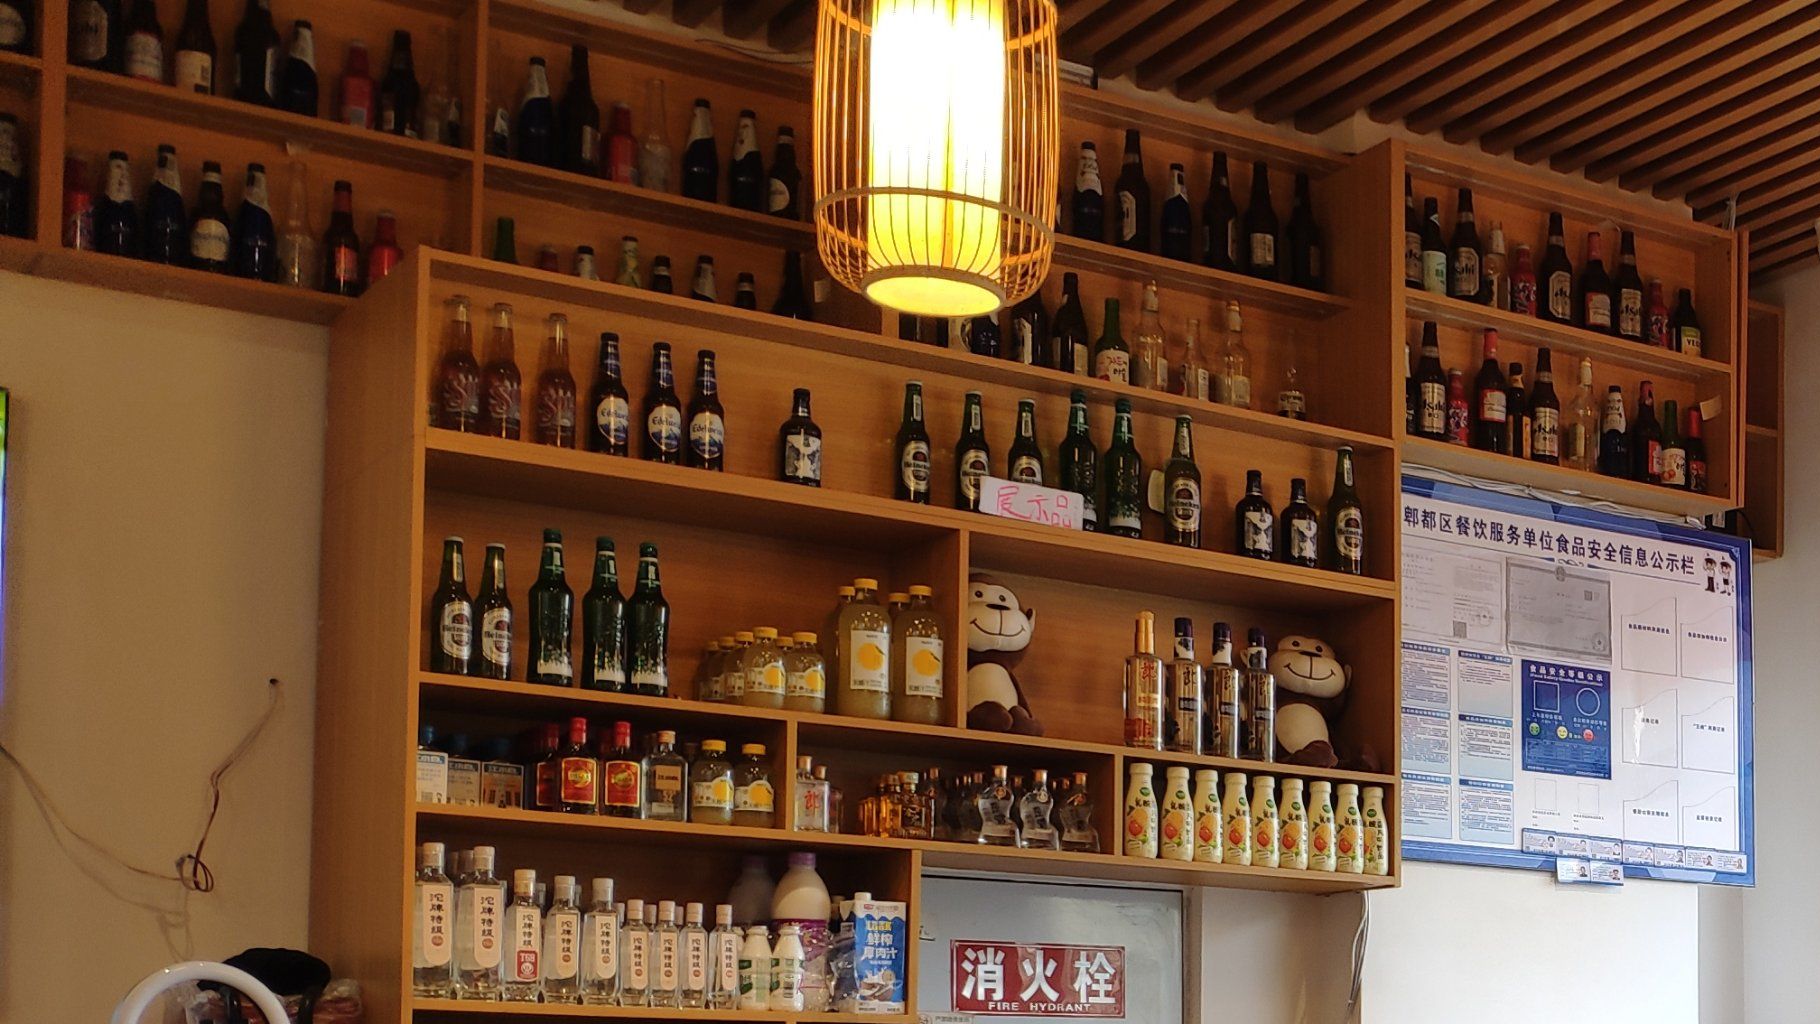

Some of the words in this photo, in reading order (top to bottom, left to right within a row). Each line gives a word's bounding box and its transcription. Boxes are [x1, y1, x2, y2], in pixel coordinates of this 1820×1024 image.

[996, 484, 1073, 530] 展示品
[1403, 504, 1695, 576] 郫都区餐饮服务单位食品安全信息公示栏
[961, 947, 1116, 1004] 消火栓
[988, 1002, 1020, 1011] FIRE
[1029, 1002, 1092, 1013] HYDRANT
